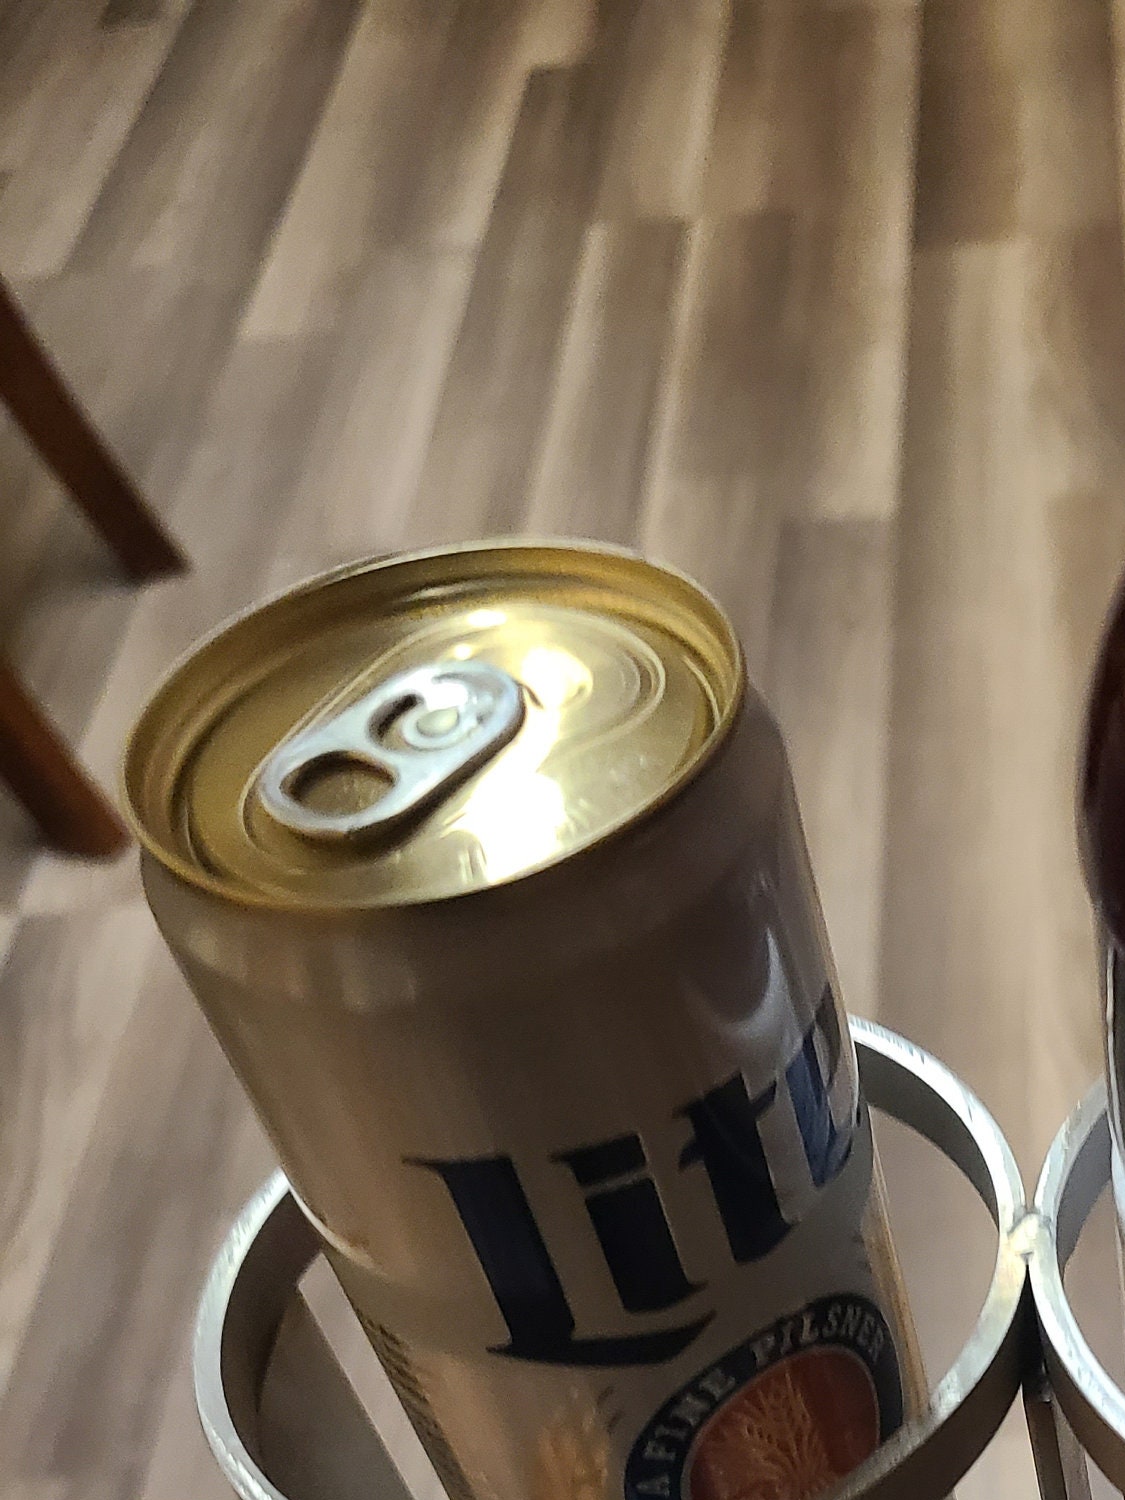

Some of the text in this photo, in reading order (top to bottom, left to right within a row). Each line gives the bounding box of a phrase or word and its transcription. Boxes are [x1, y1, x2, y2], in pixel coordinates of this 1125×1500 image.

[402, 982, 852, 1366] Lite
[634, 1302, 886, 1500] A FINE PILSNER
